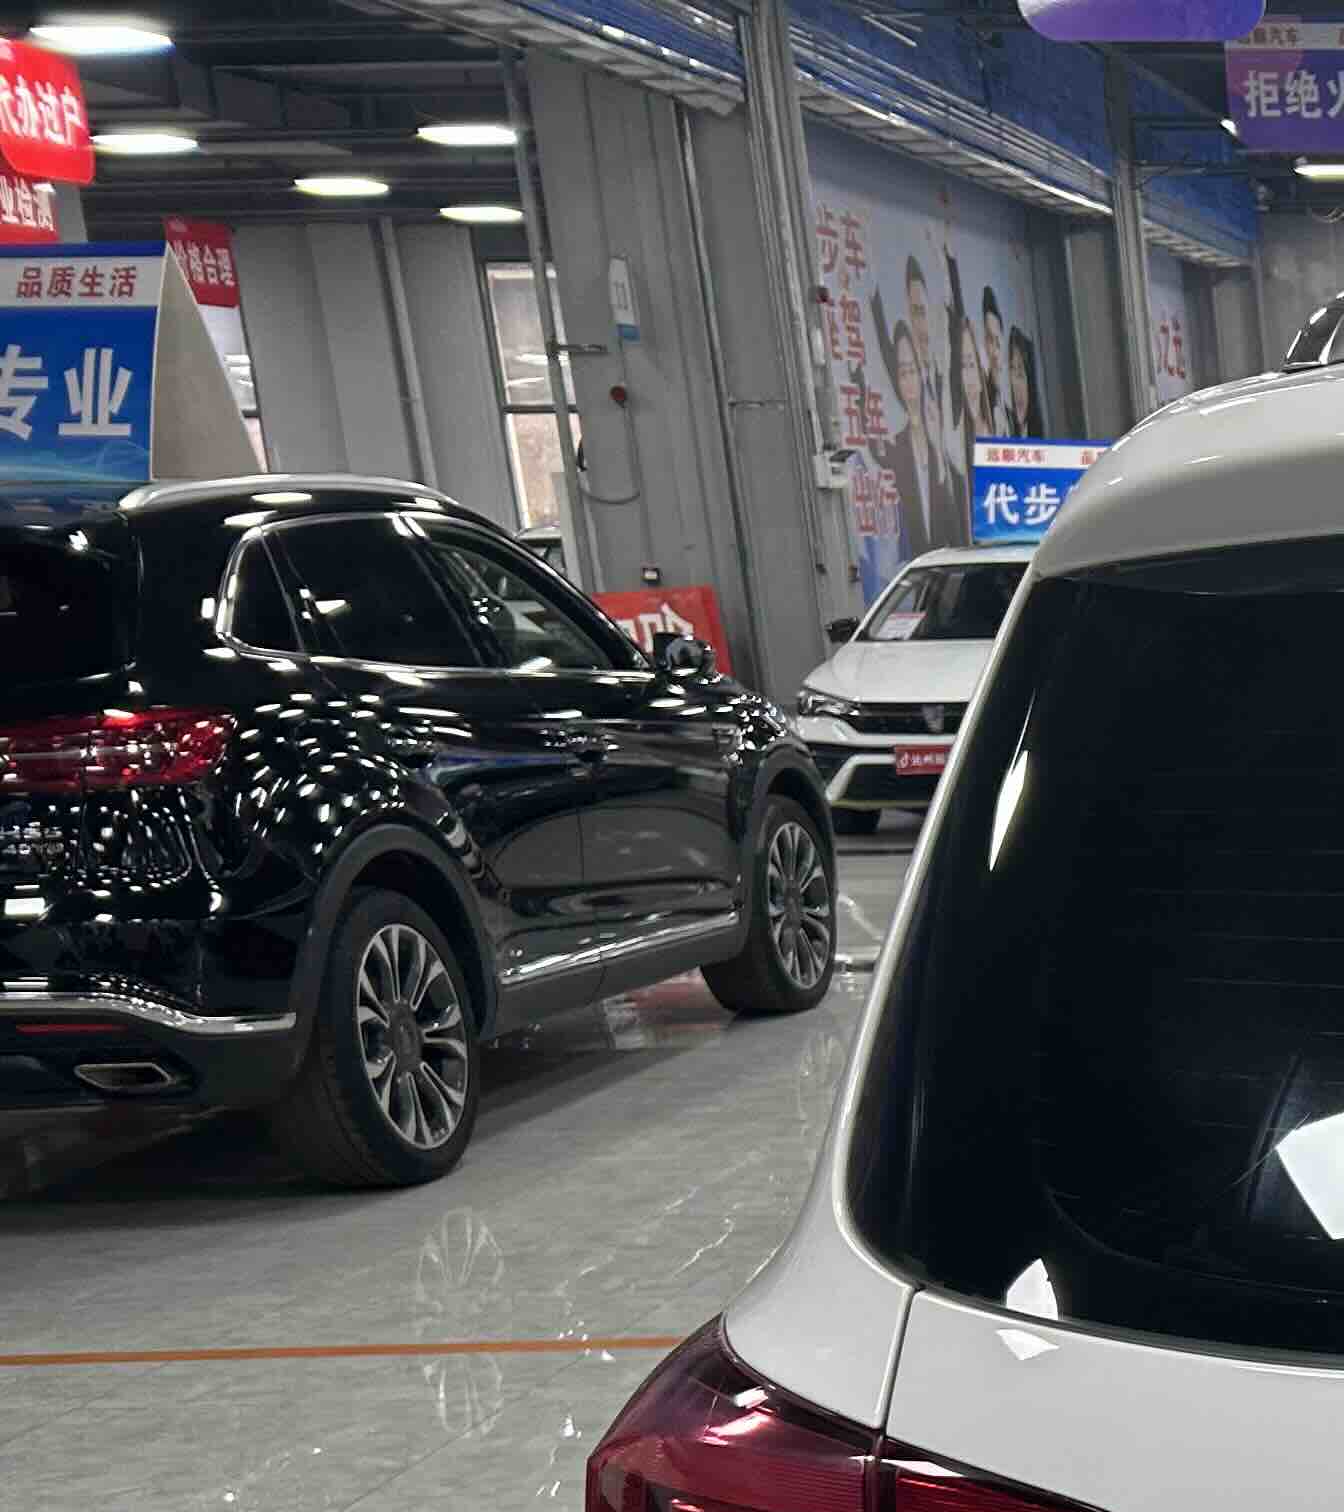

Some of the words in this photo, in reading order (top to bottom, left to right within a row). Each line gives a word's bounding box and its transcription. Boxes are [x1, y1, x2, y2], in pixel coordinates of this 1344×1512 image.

[16, 265, 137, 298] 品质生活
[0, 344, 133, 441] 专业
[983, 483, 1076, 525] 代步
